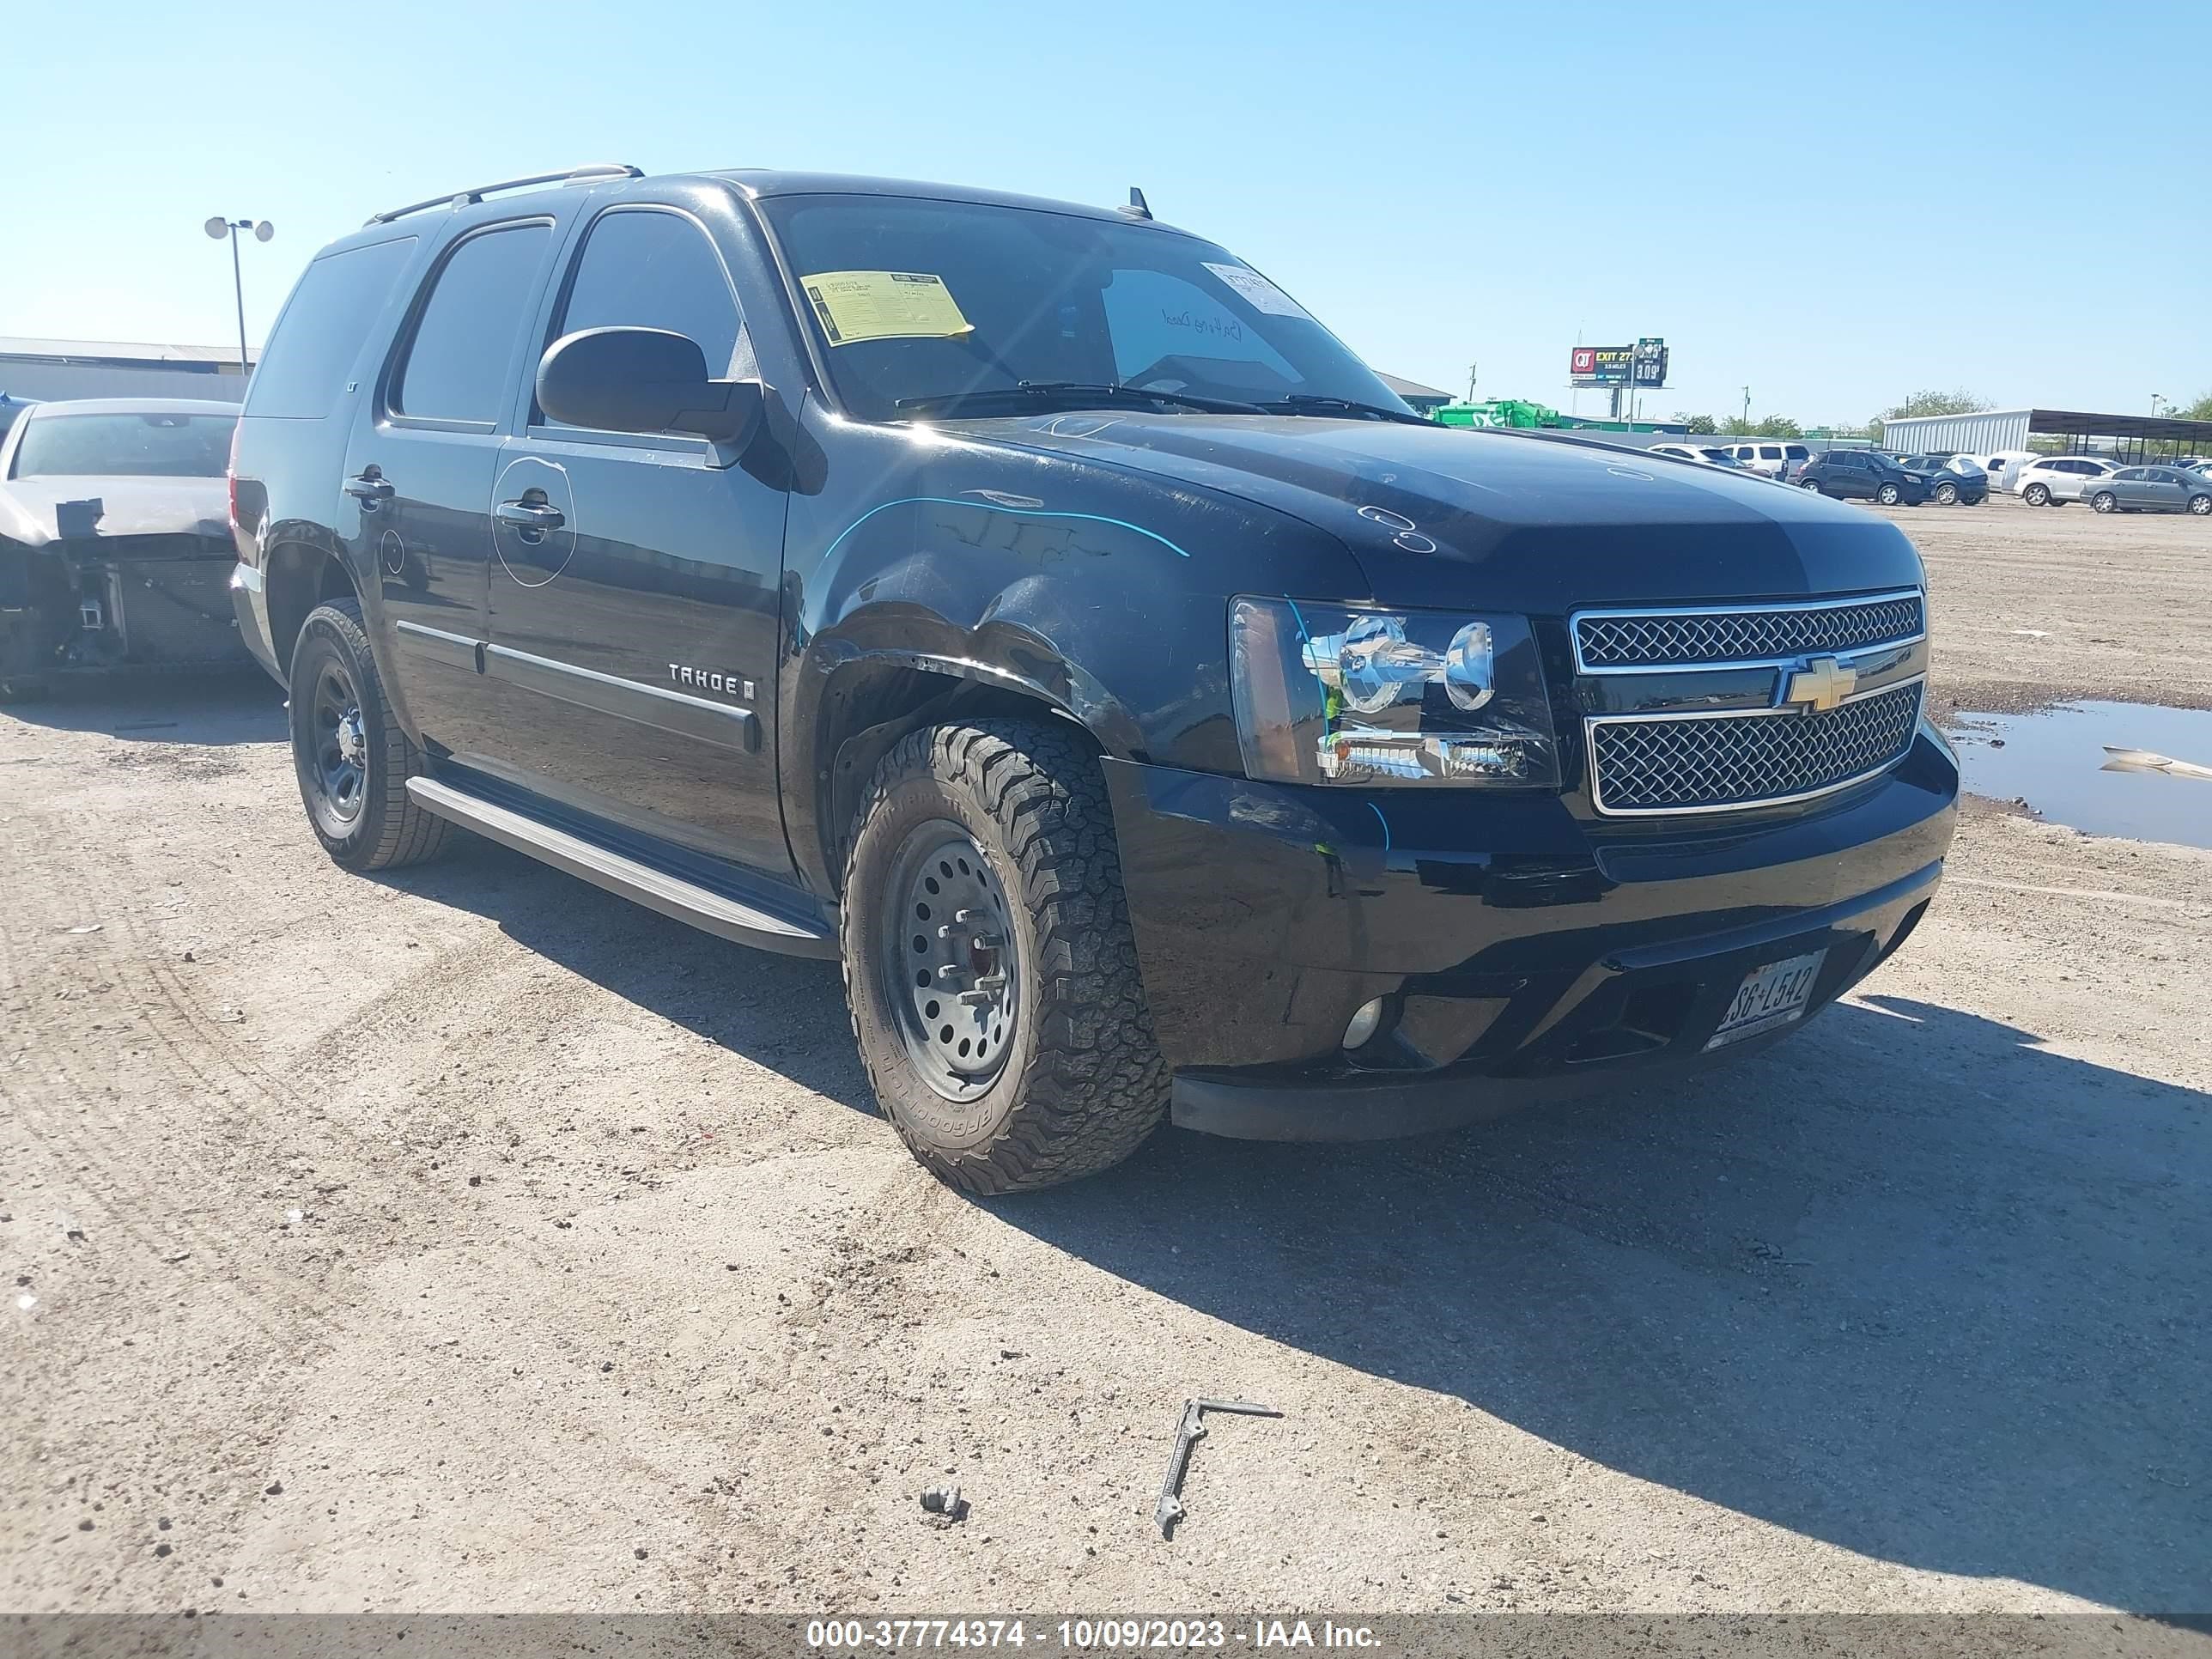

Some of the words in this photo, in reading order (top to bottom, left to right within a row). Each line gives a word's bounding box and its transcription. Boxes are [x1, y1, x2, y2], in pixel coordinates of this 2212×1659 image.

[1575, 352, 1592, 368] QT
[1595, 351, 1617, 362] EXIT
[668, 663, 738, 696] TAHOE
